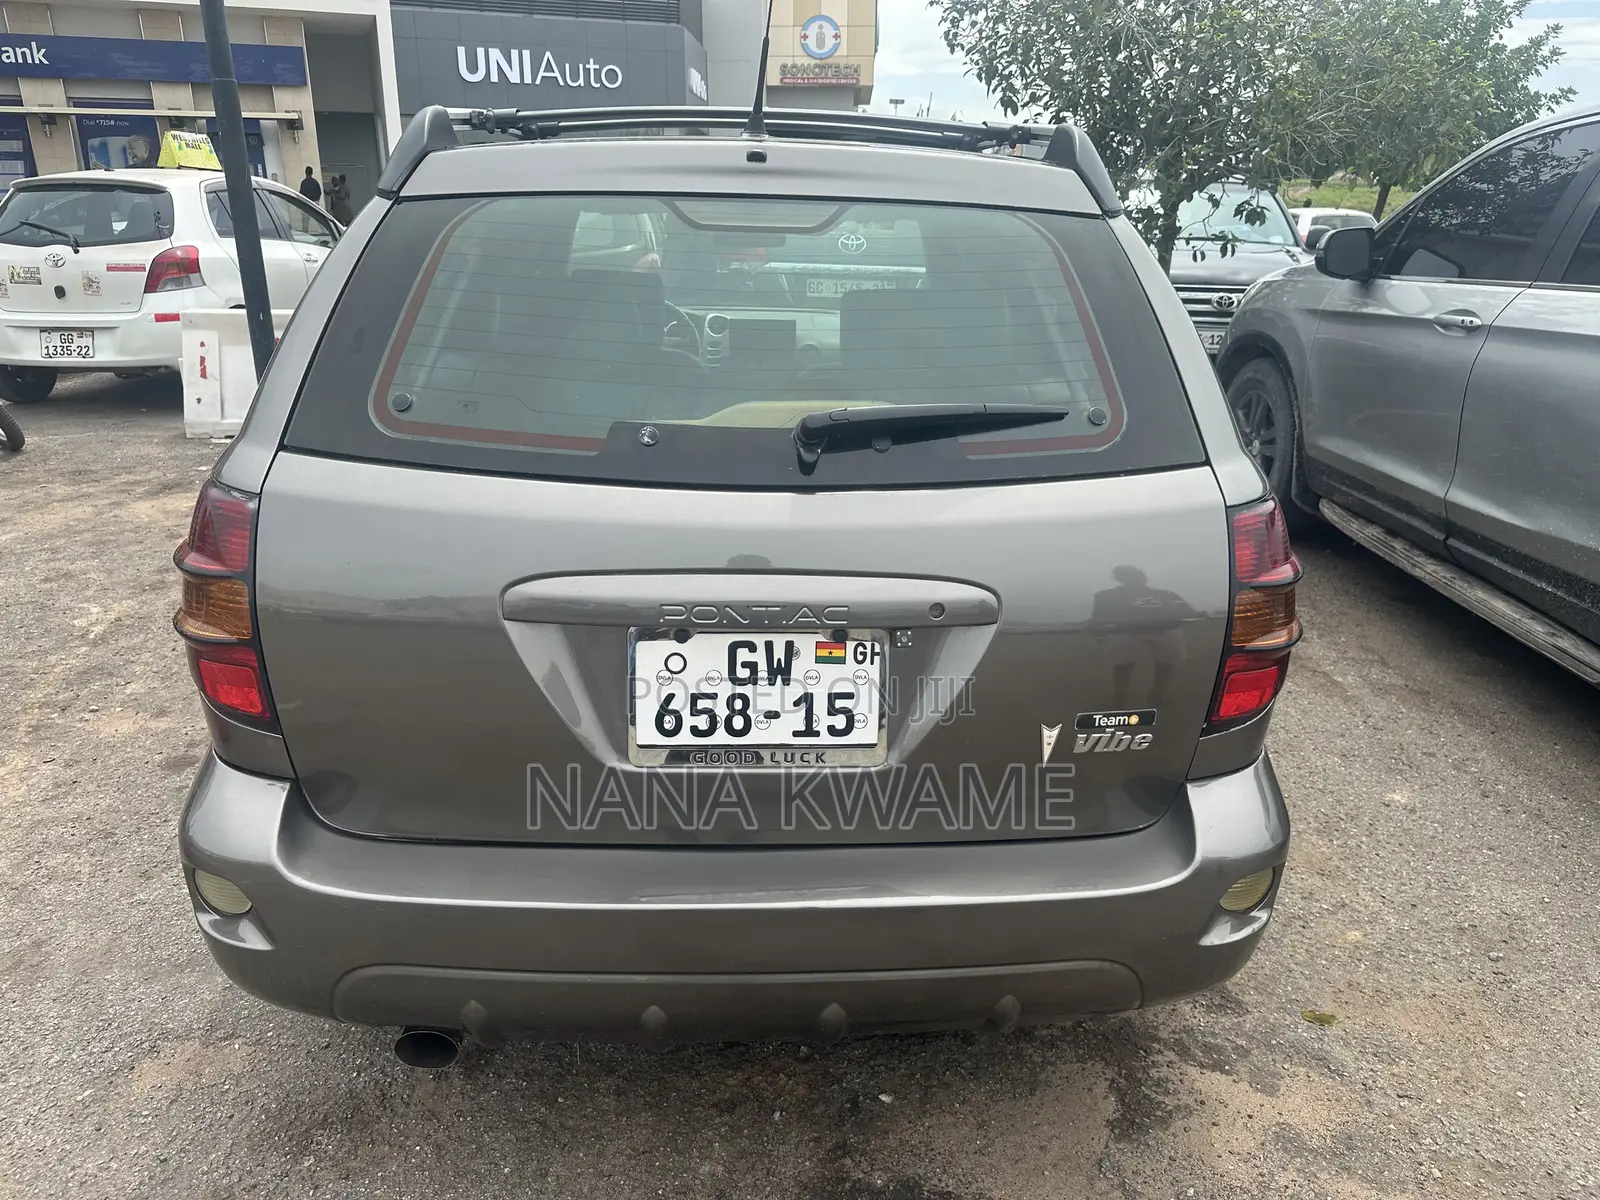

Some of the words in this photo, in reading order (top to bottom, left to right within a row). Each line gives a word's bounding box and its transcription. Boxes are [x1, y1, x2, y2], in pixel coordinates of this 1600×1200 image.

[0, 41, 50, 65] ank
[456, 46, 623, 88] UNIAuto
[780, 63, 861, 76] SONOTECH
[185, 141, 202, 150] MALL
[60, 333, 74, 344] GG
[44, 345, 90, 356] 1335-22
[660, 604, 849, 625] PONTIAC
[728, 640, 795, 686] GW
[655, 692, 856, 738] 658-15
[1093, 715, 1128, 727] Team
[690, 751, 756, 765] GOOD
[770, 751, 827, 765] LUCK
